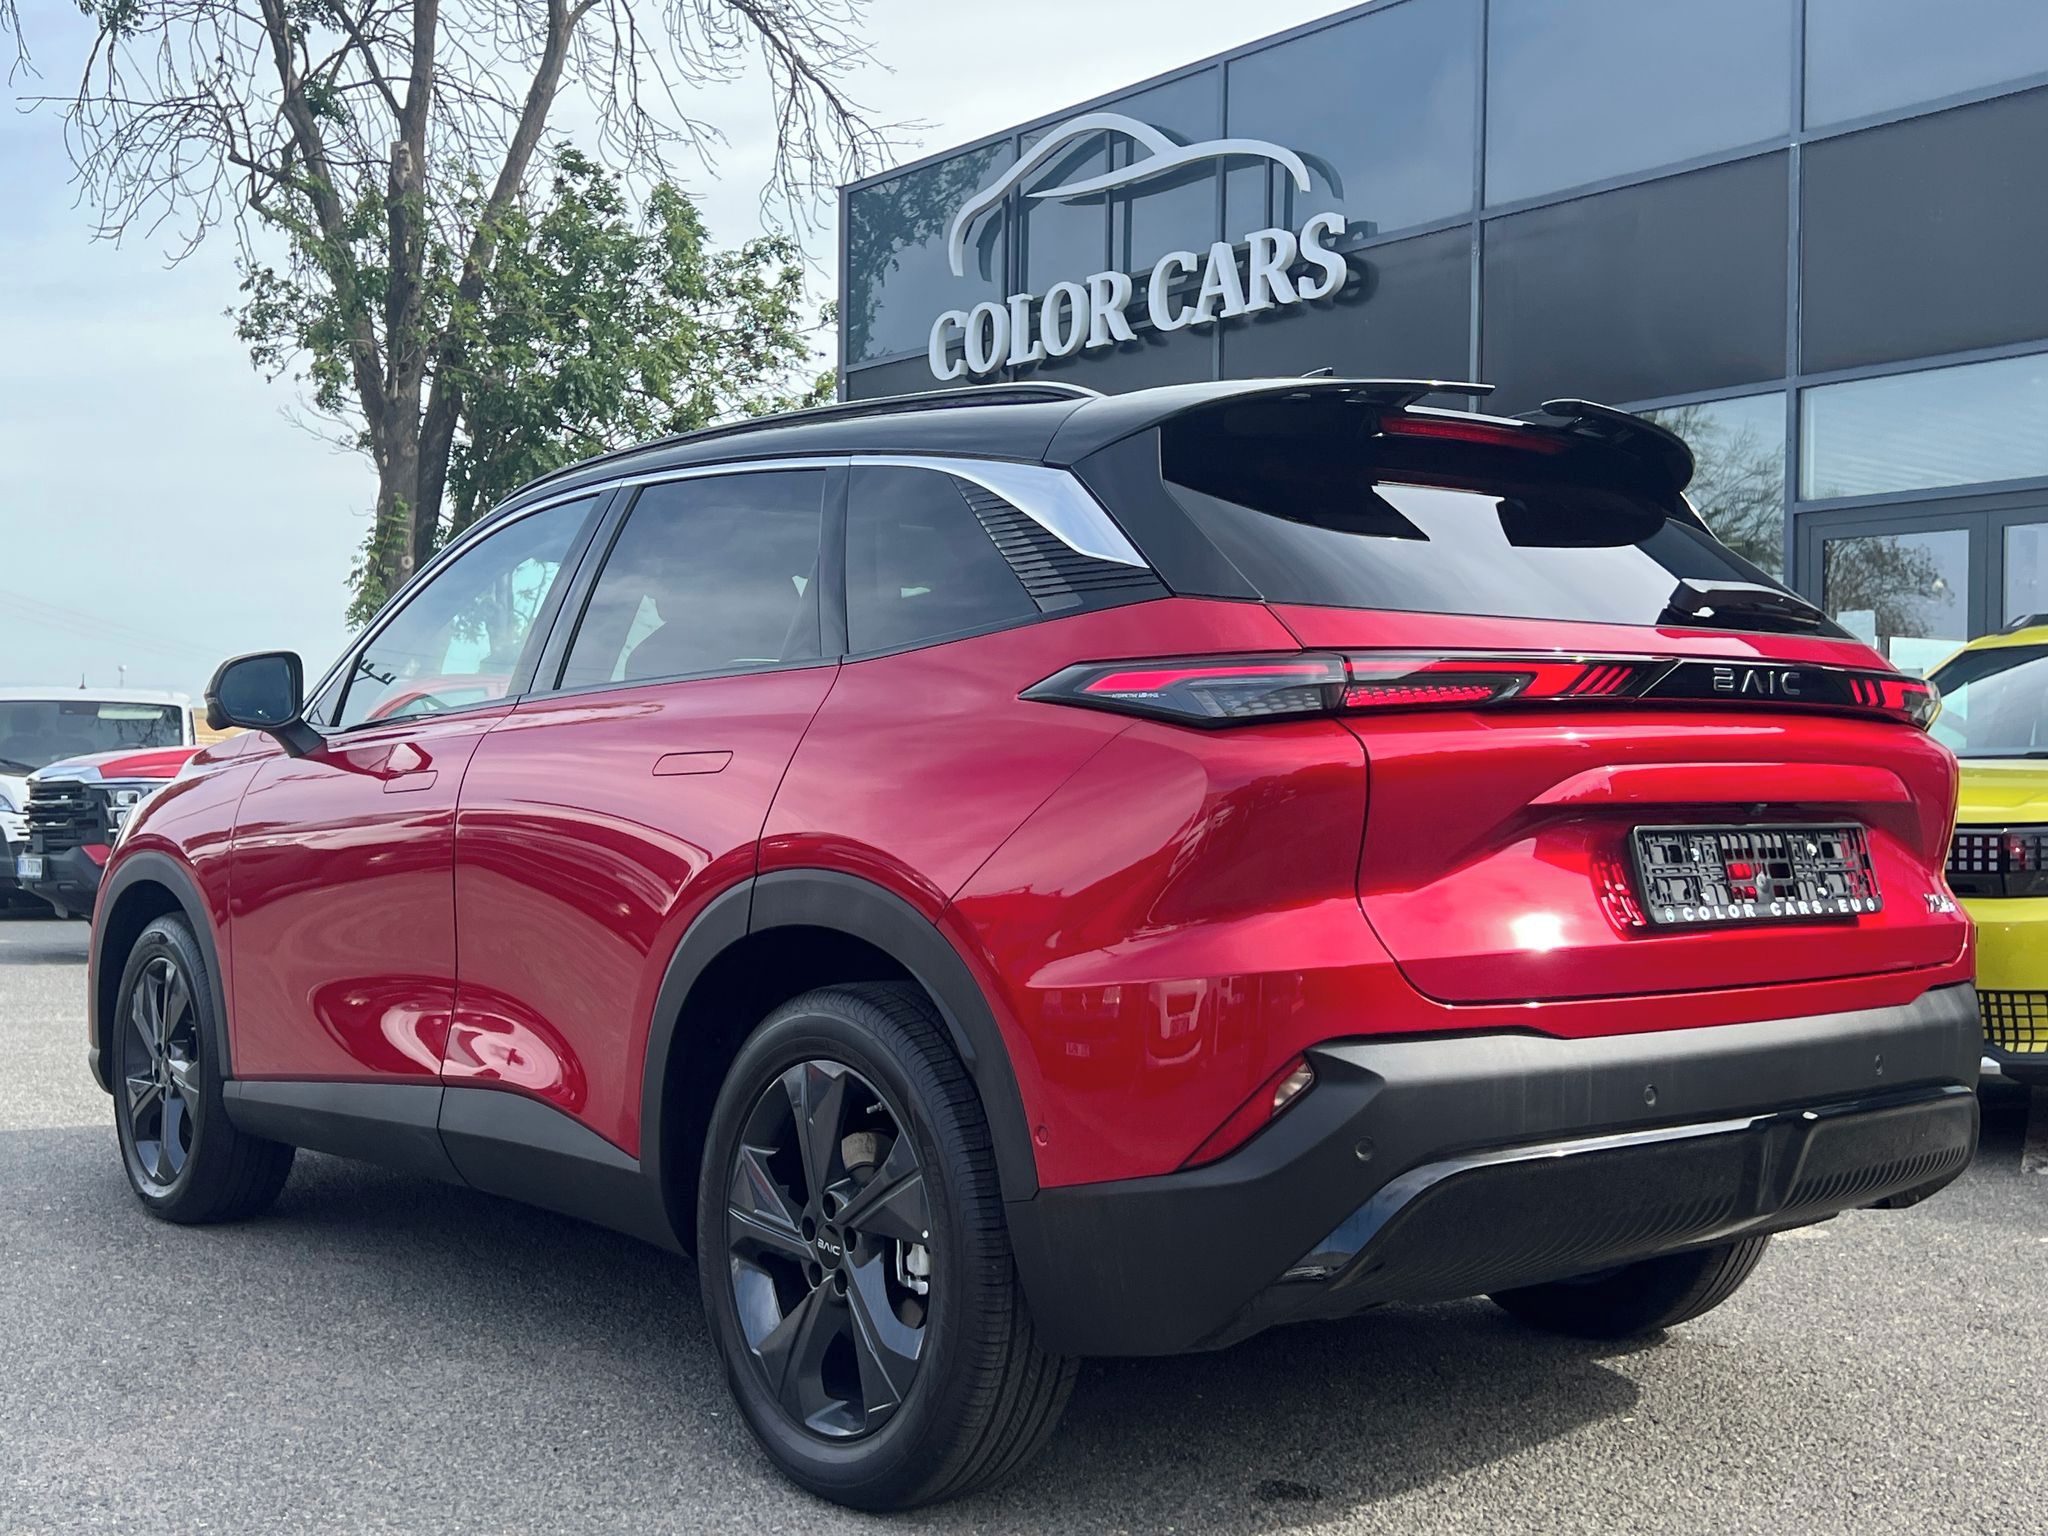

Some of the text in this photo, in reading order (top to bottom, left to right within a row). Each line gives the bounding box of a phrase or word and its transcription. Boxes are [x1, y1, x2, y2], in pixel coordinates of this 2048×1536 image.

[928, 212, 1347, 381] COLOR CARS
[1713, 667, 1801, 695] BAIC
[1682, 904, 1757, 922] COLOR
